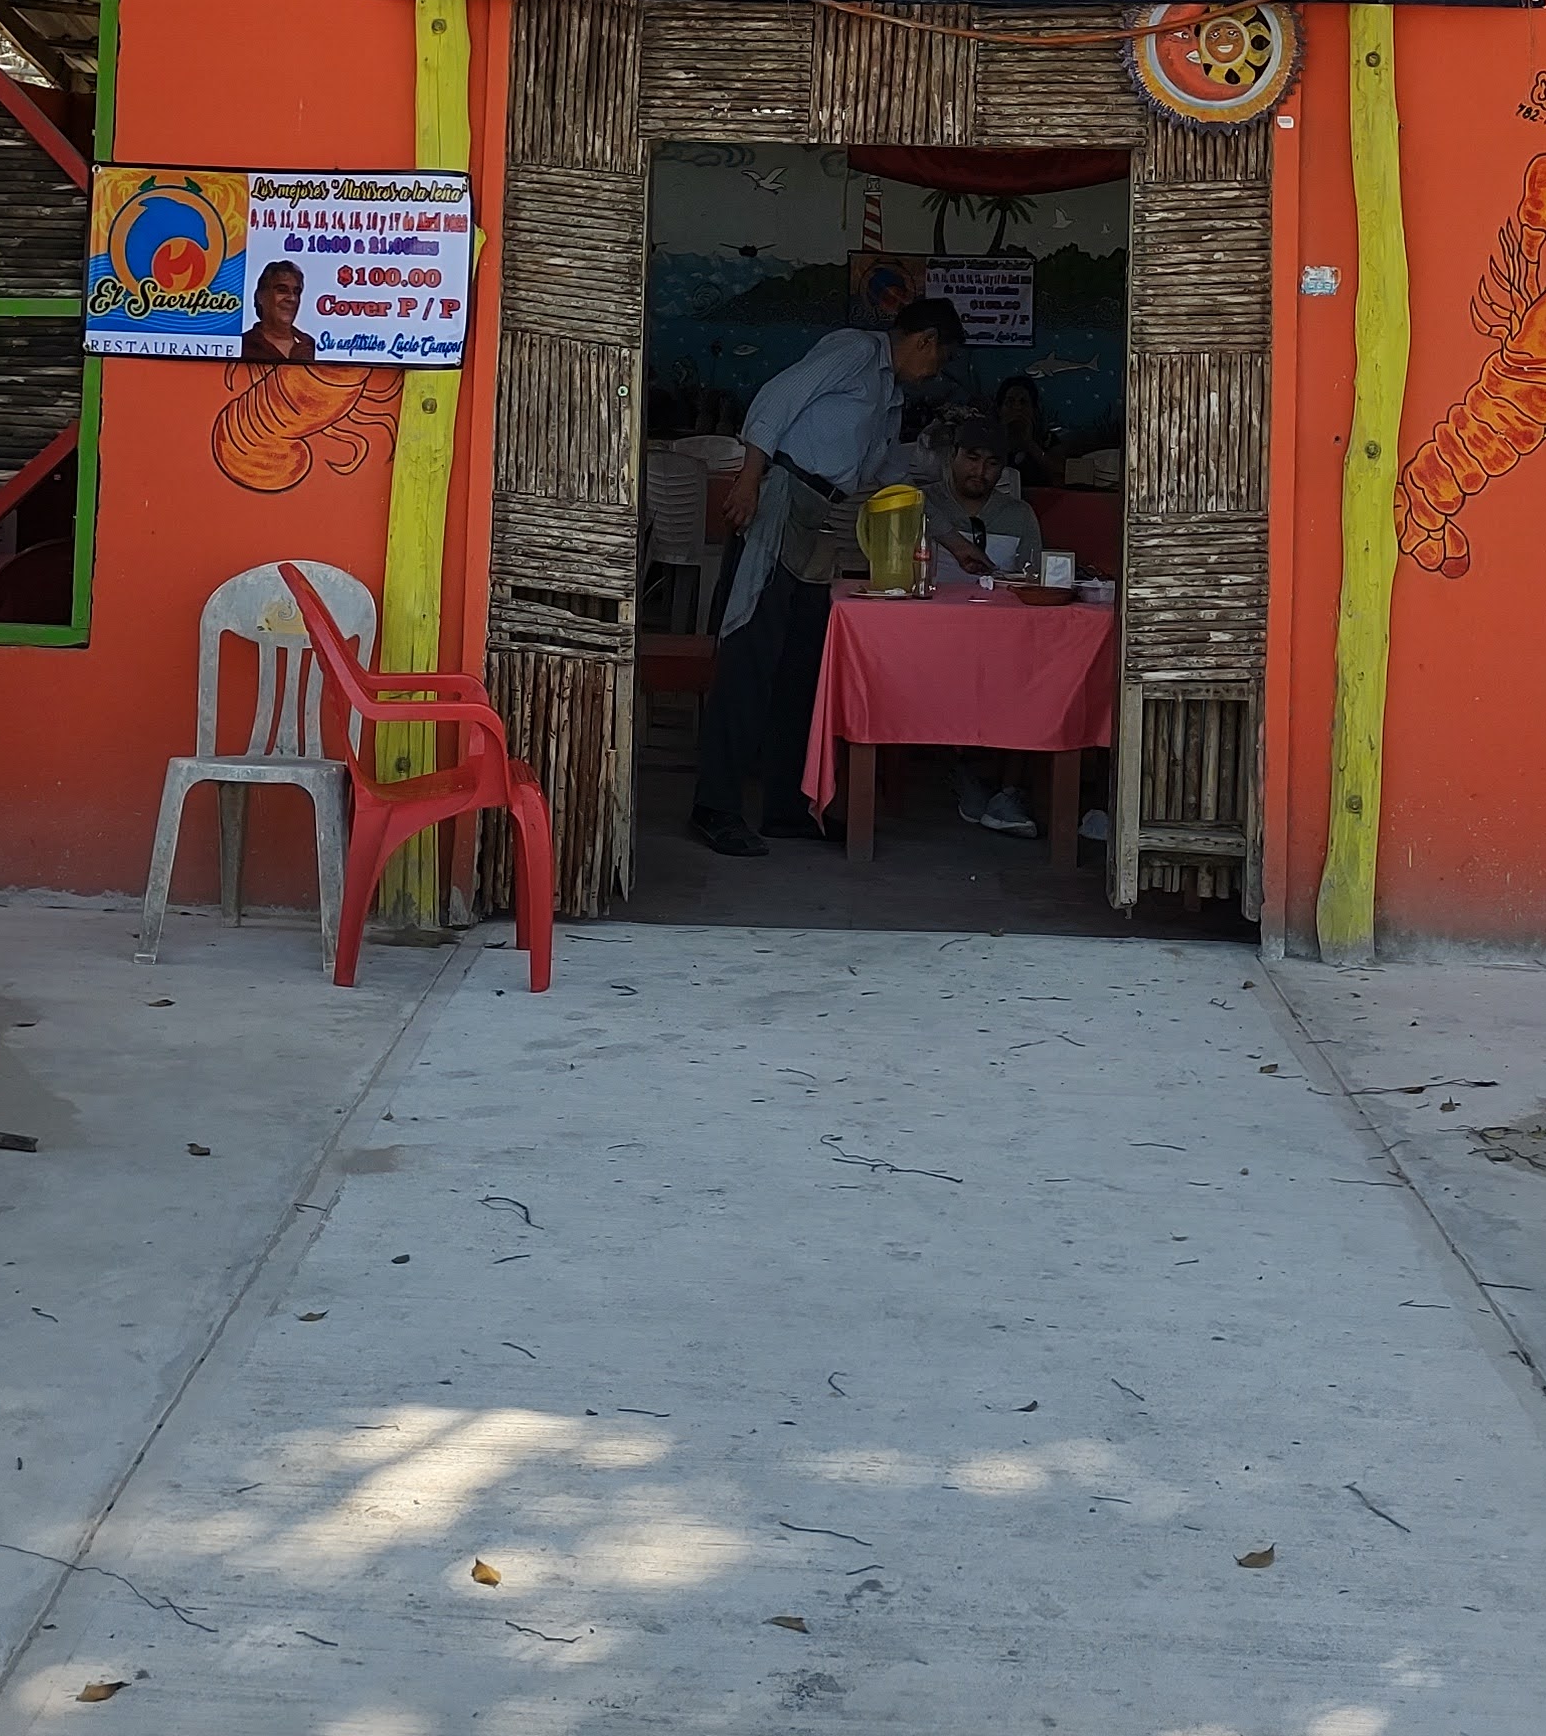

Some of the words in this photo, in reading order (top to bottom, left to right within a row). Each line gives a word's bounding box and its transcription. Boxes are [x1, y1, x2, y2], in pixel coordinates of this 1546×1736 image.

[251, 176, 275, 201] Los
[277, 179, 328, 209] mejores
[399, 186, 413, 201] a
[412, 180, 430, 202] la
[280, 209, 293, 231] 11,
[389, 212, 401, 231] 17
[337, 265, 442, 289] $100.00
[89, 277, 124, 315] El
[126, 278, 240, 318] Sacrificio
[316, 294, 392, 318] Cover
[397, 297, 418, 318] P
[422, 297, 435, 321] /
[439, 298, 461, 319] P
[90, 339, 235, 357] RESTAURANTE
[316, 330, 336, 352] Su
[387, 332, 421, 359] Lucio
